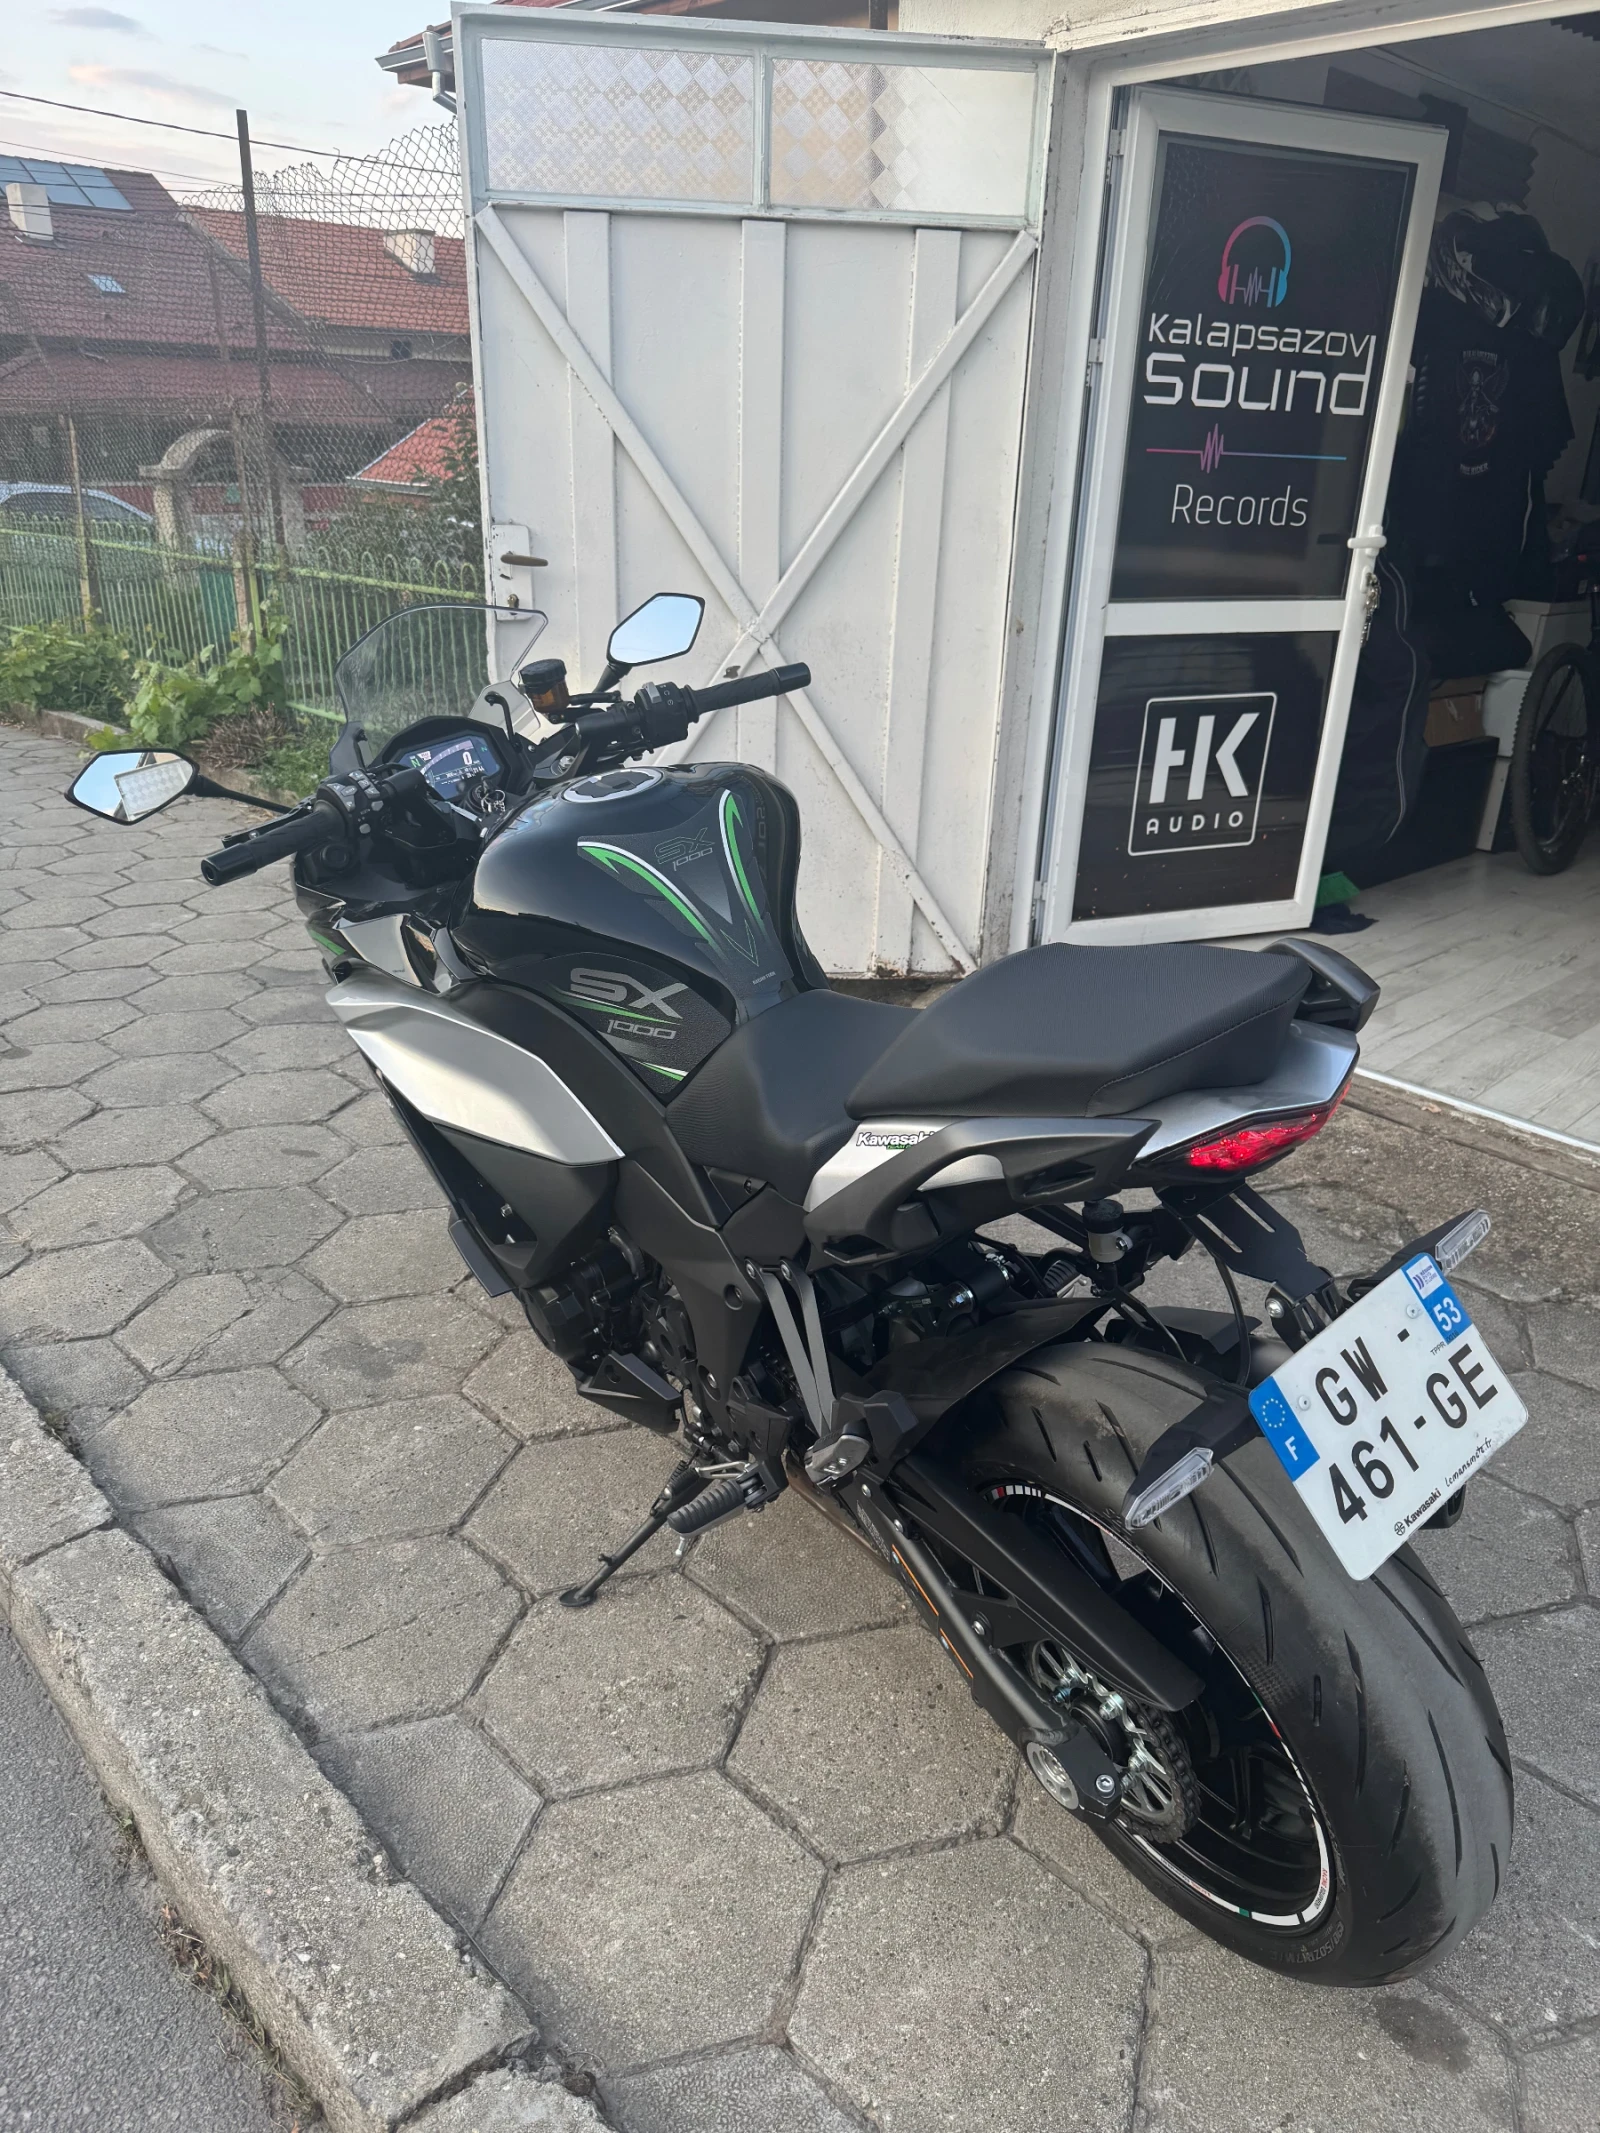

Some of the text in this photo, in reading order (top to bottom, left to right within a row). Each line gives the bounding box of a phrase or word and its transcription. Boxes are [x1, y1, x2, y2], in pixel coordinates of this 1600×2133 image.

[1171, 484, 1309, 527] Records
[1148, 712, 1260, 804] HK
[1146, 810, 1244, 836] AUDIO
[654, 827, 715, 864] SX
[672, 847, 713, 871] 1000
[570, 967, 689, 1019] SX
[607, 1019, 677, 1040] 1000
[1433, 1297, 1462, 1331] 53
[1284, 1435, 1300, 1461] F
[1403, 1487, 1441, 1527] Kawasaki
